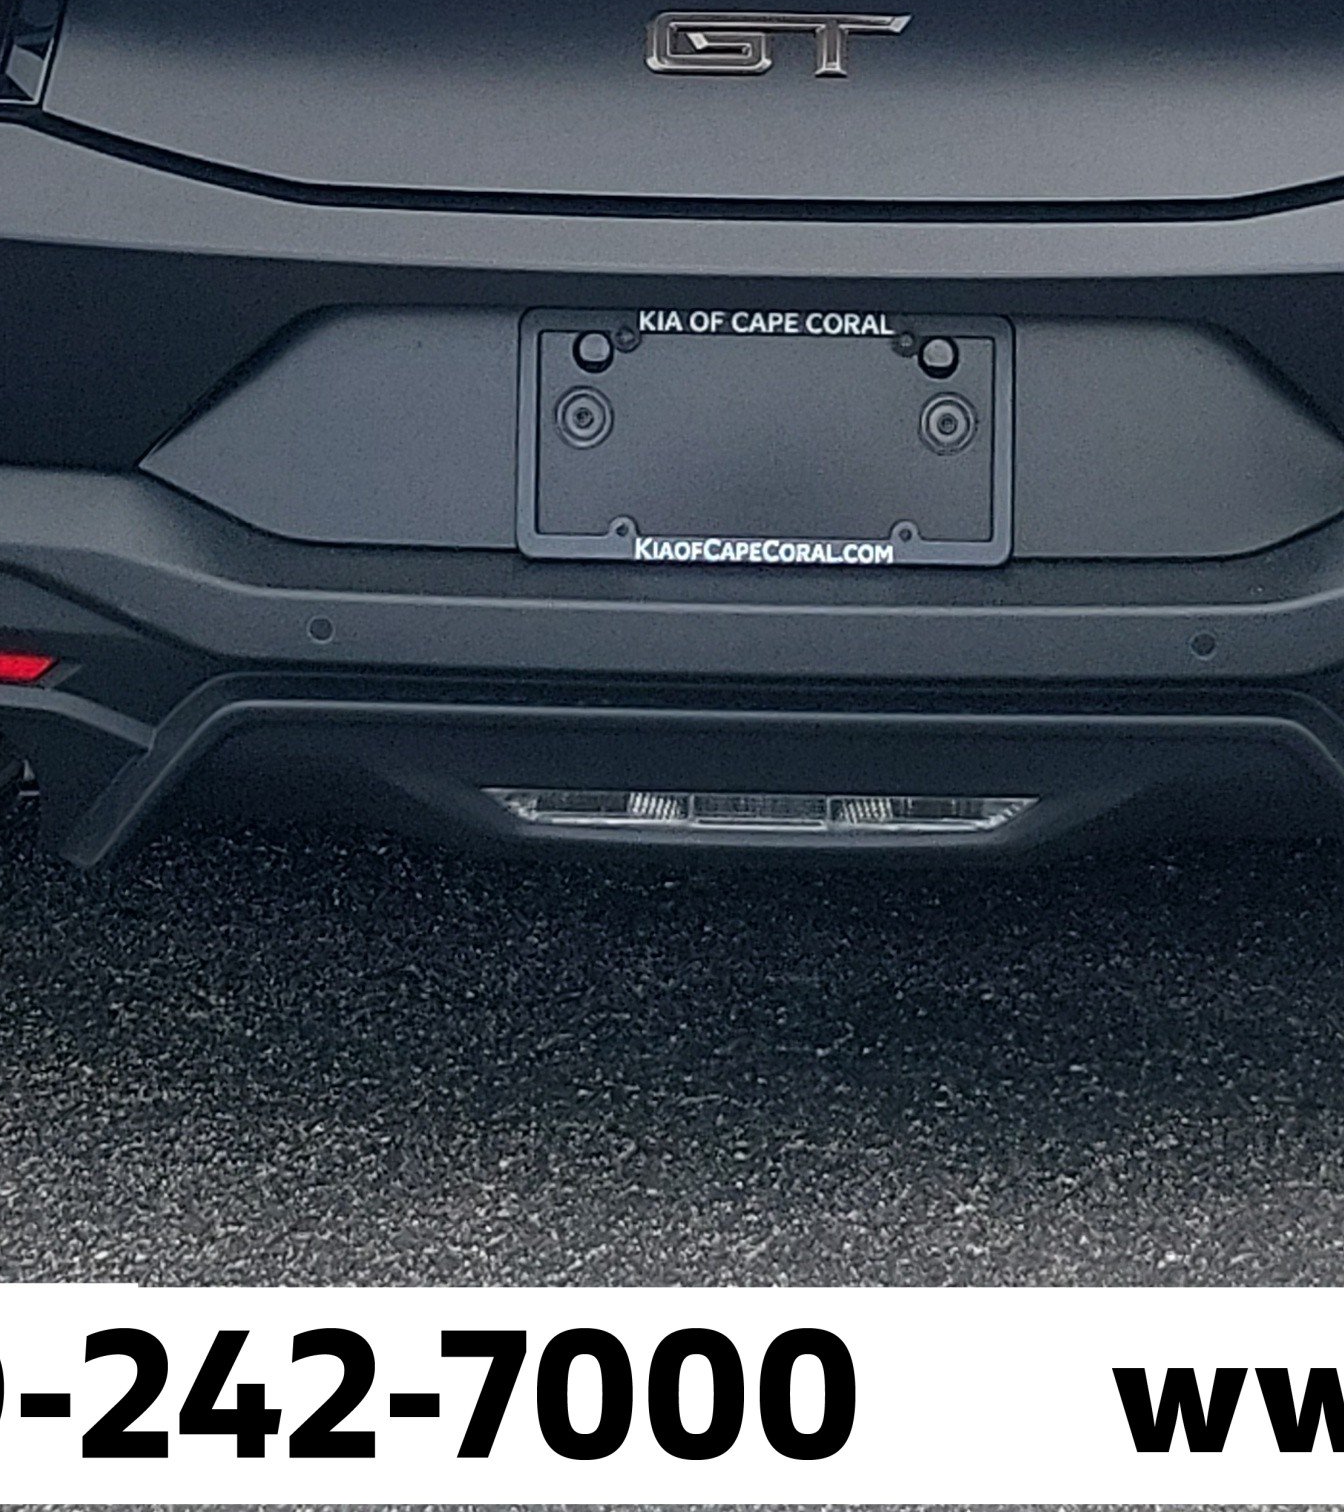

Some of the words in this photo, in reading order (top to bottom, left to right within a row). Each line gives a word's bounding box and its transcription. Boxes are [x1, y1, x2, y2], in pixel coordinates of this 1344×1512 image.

[644, 11, 915, 78] GT
[638, 309, 684, 332] KIA
[688, 309, 724, 333] OF
[730, 310, 800, 334] CAPE
[804, 312, 895, 336] CORAL
